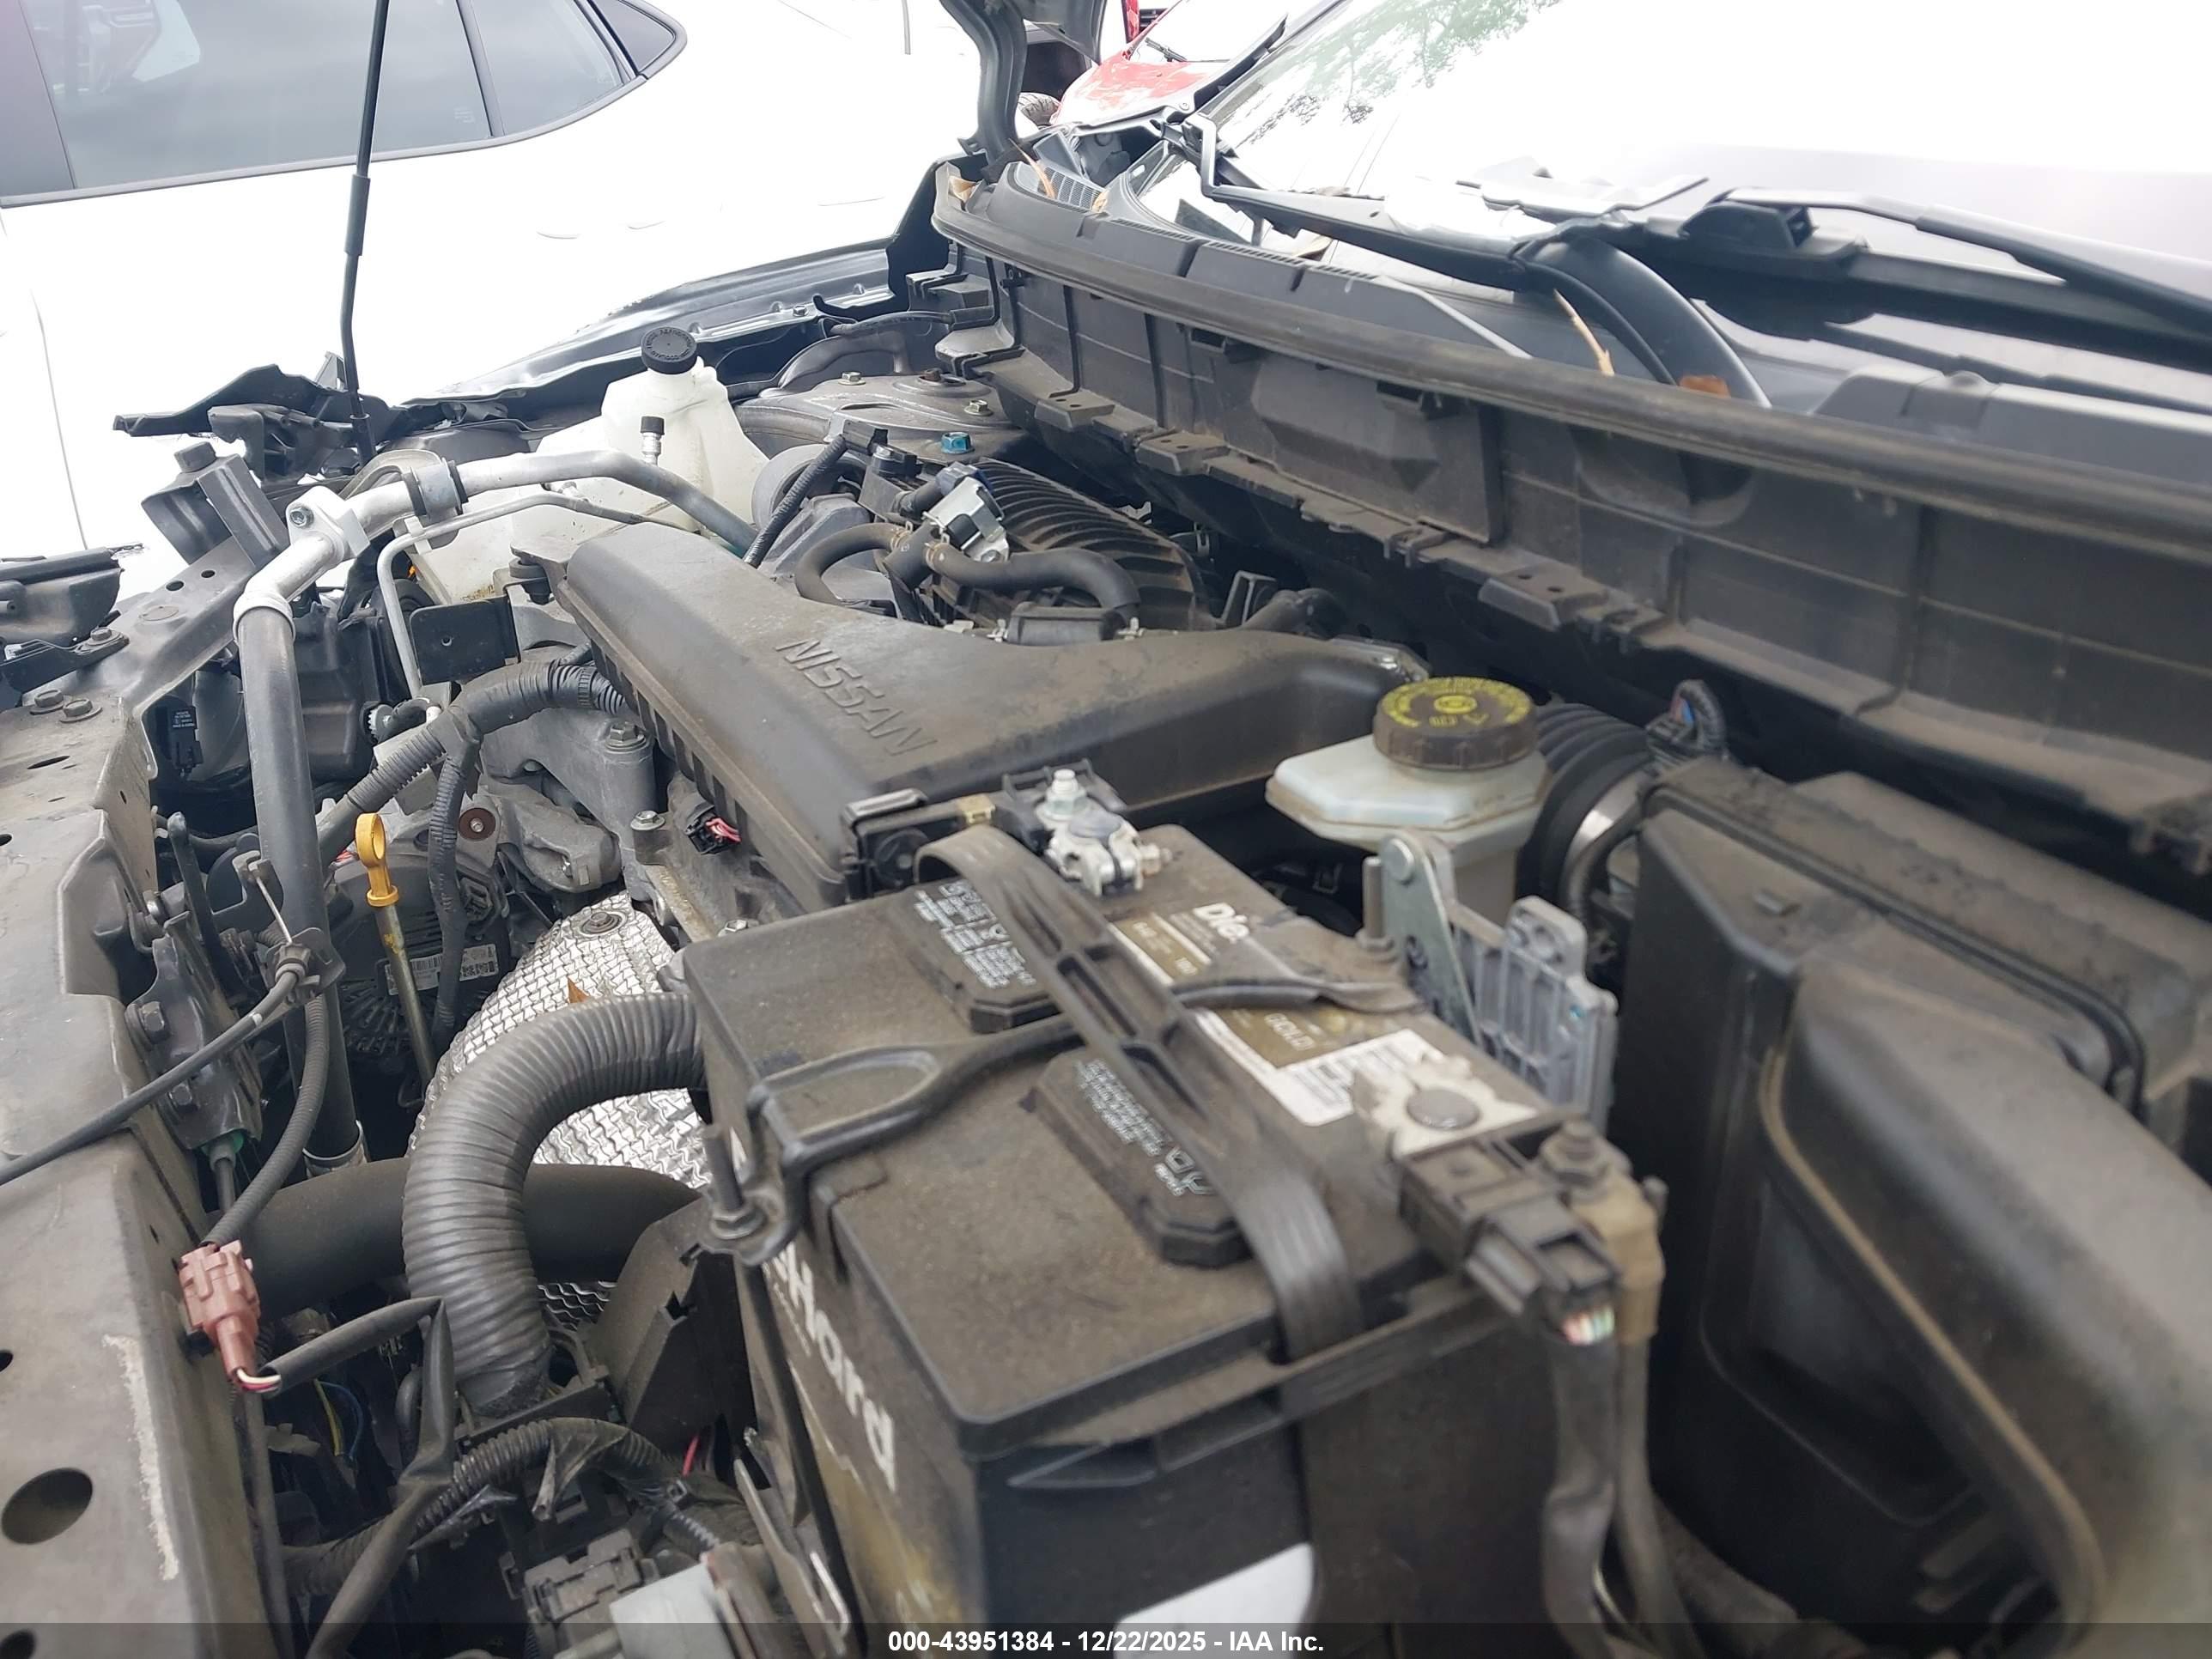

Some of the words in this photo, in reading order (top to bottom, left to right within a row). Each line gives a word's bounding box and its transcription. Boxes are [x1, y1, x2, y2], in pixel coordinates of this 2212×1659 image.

[775, 637, 938, 756] NISSAN
[1193, 902, 1250, 944] Die
[1264, 1012, 1316, 1051] GOLD
